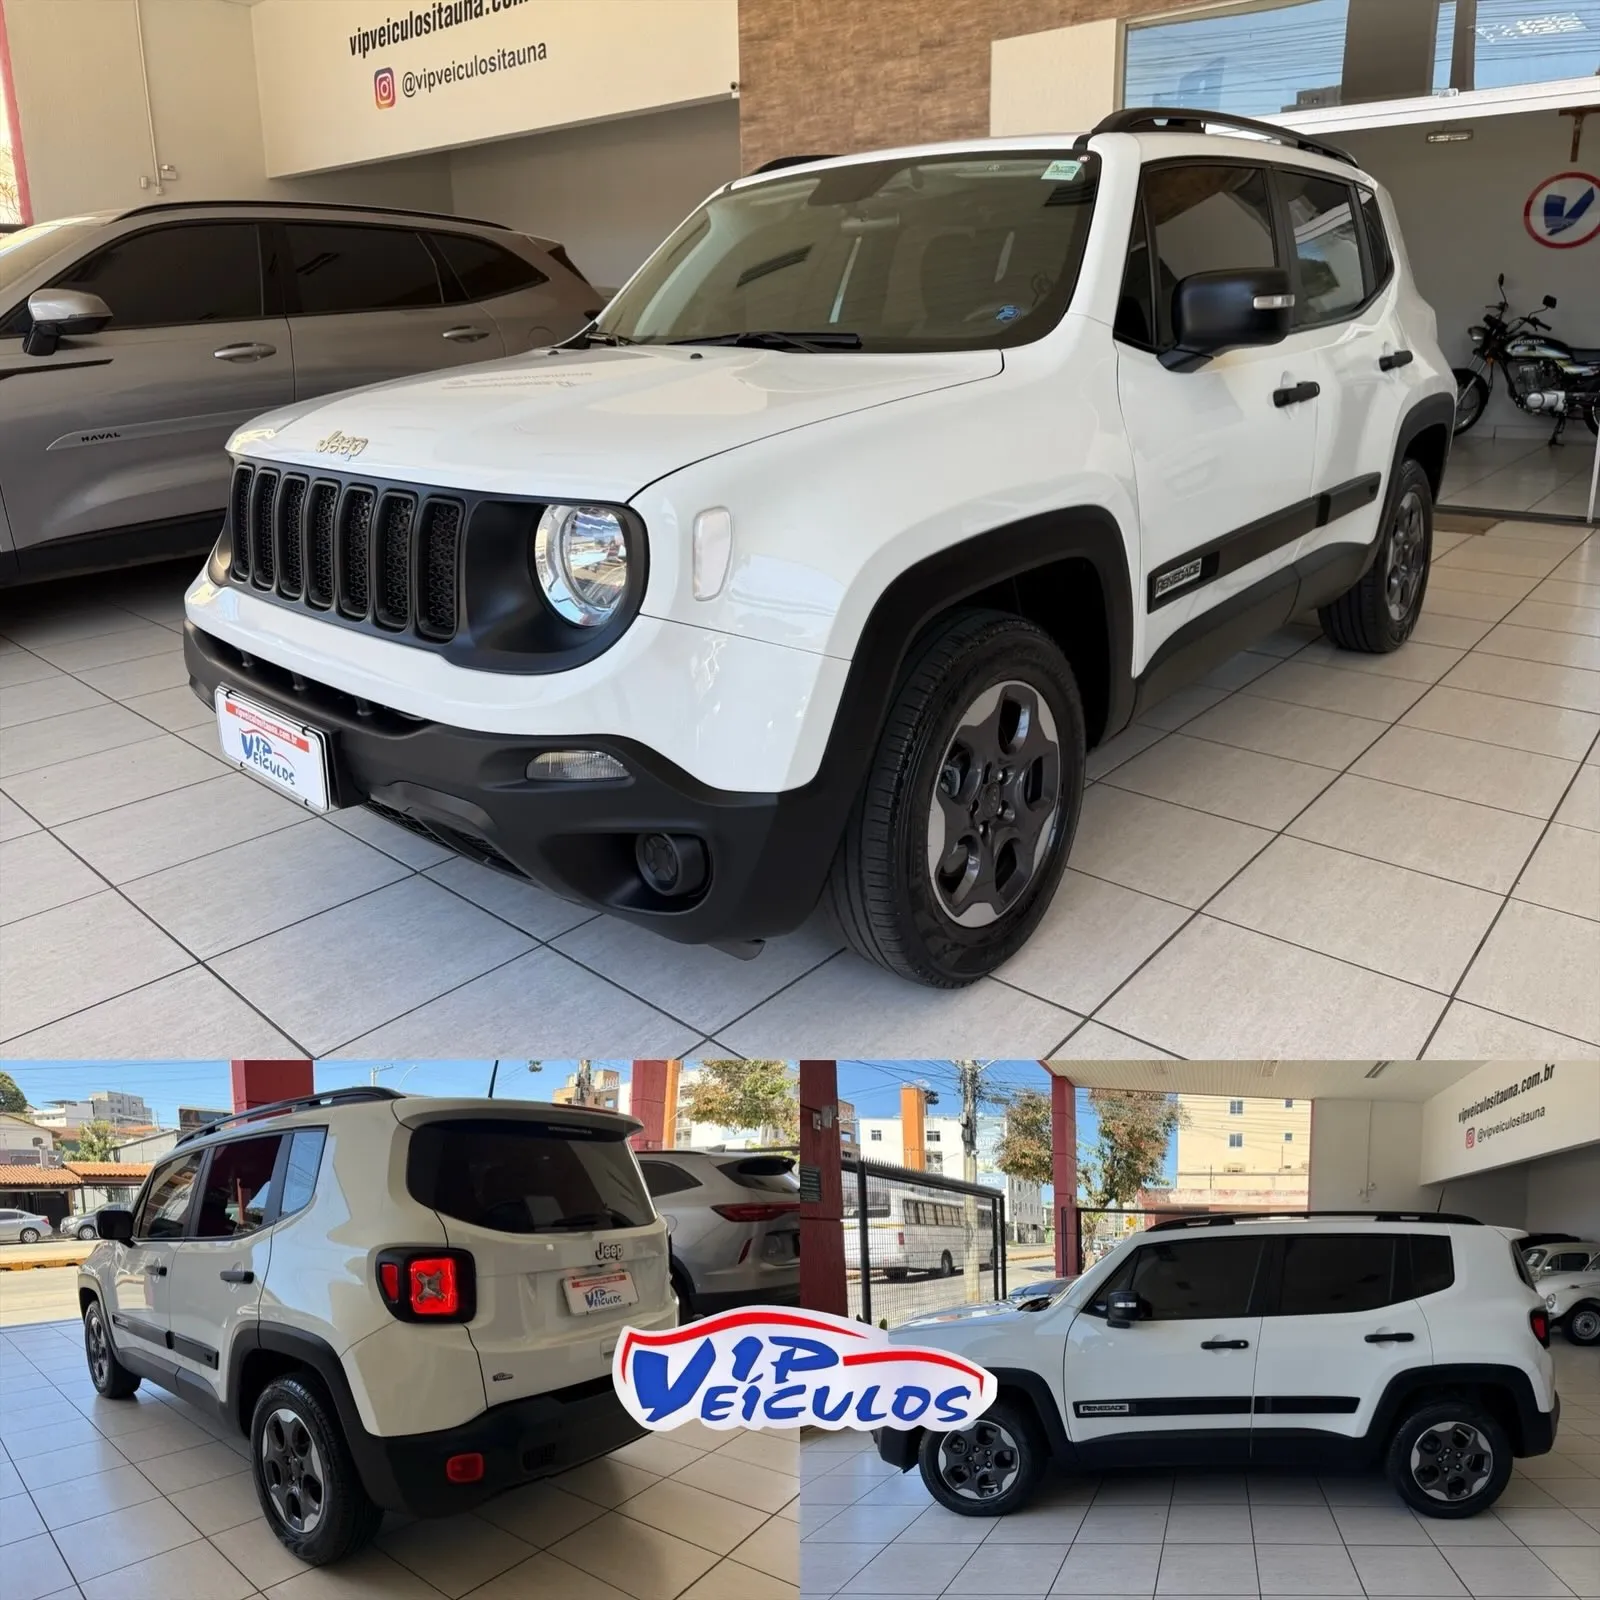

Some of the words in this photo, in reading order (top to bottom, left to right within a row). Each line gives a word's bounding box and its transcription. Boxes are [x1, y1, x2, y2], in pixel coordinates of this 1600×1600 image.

[349, 0, 528, 58] vipveiculositauna.c
[402, 42, 547, 98] @vipveiculositauna
[81, 432, 121, 442] HAVAL
[316, 430, 368, 462] Jeep
[1458, 1063, 1555, 1124] vipveiculositauna.com.br
[1477, 1105, 1546, 1143] @vipveiculositauna
[595, 1242, 623, 1260] Jeep
[1082, 1405, 1127, 1413] RENEGADE
